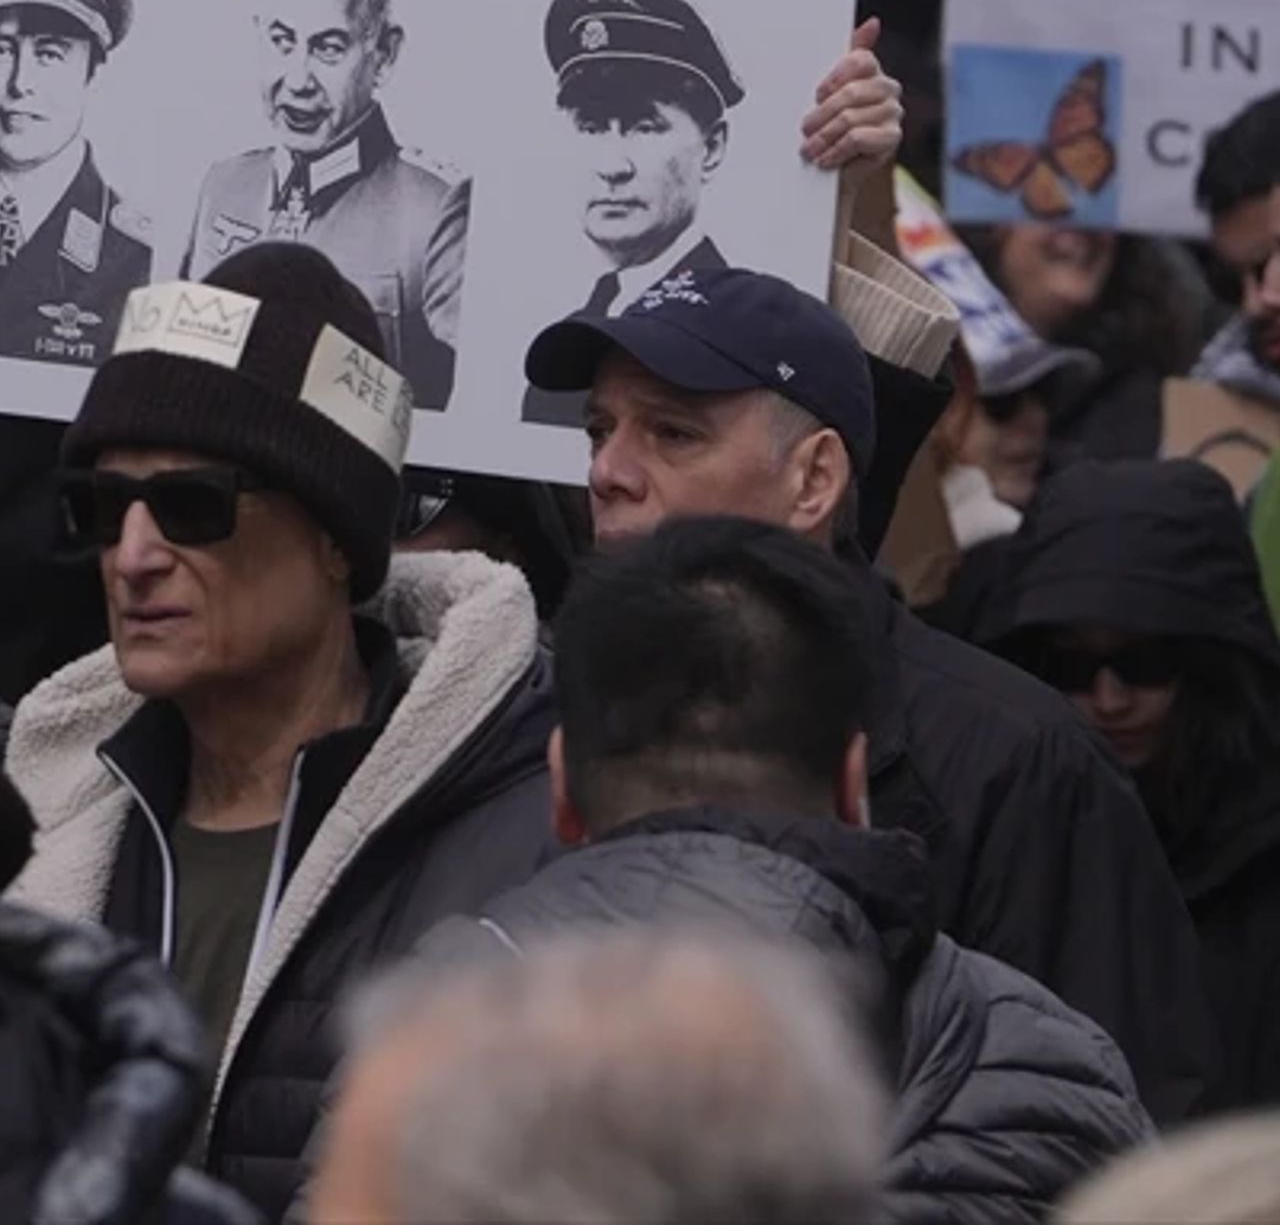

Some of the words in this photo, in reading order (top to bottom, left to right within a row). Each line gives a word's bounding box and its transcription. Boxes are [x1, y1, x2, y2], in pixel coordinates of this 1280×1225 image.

[1180, 22, 1260, 75] IN
[342, 347, 389, 392] ALL
[332, 371, 387, 415] ARE
